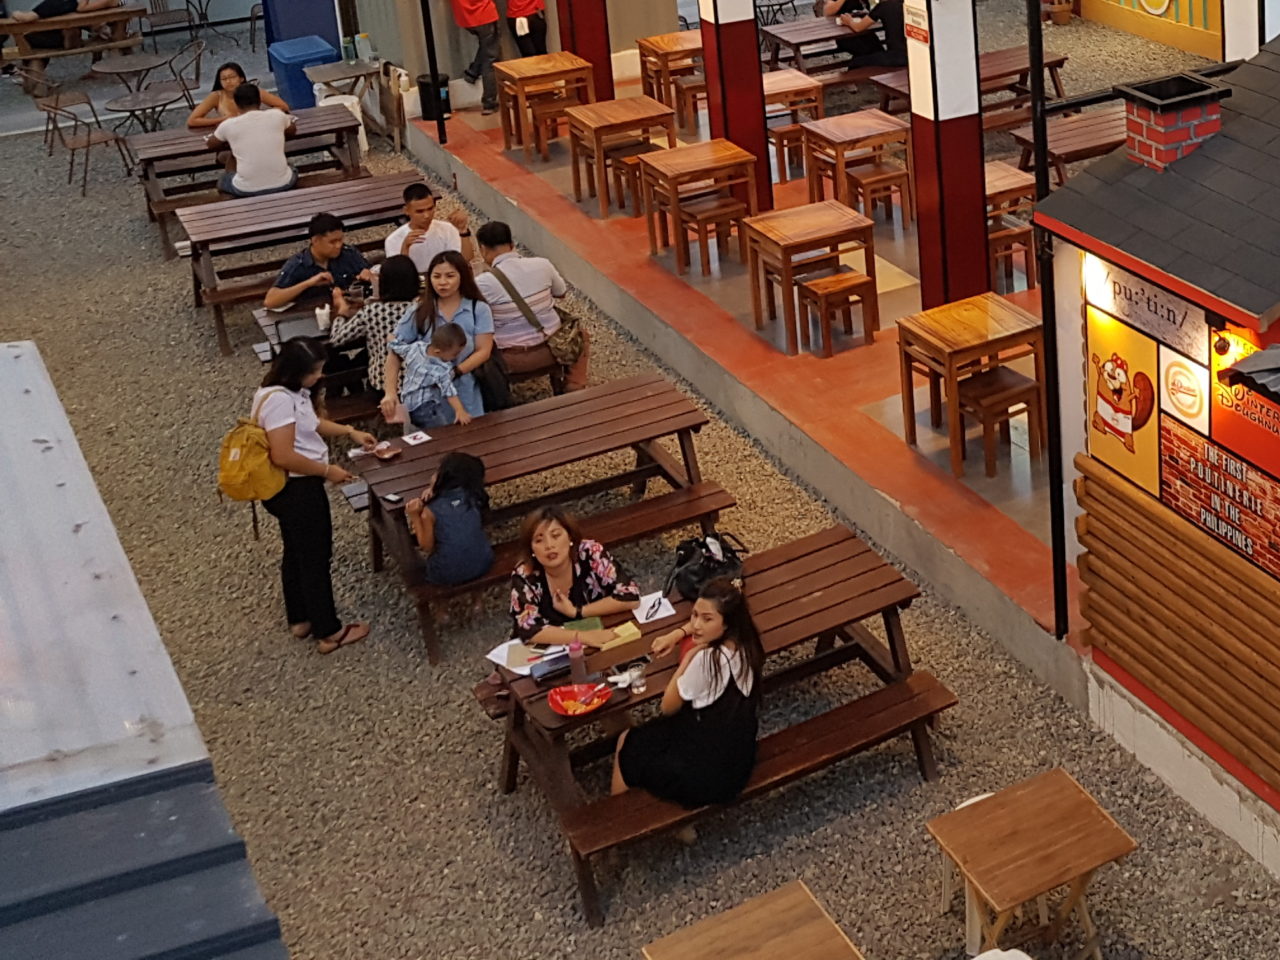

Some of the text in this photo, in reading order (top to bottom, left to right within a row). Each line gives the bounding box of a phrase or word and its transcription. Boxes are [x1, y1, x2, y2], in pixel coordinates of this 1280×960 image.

[1203, 441, 1247, 483] THE FIRST
[1189, 457, 1263, 517] POUTINERIE
[1210, 491, 1241, 525] IN THE
[1200, 507, 1254, 556] PHILIPPINES
